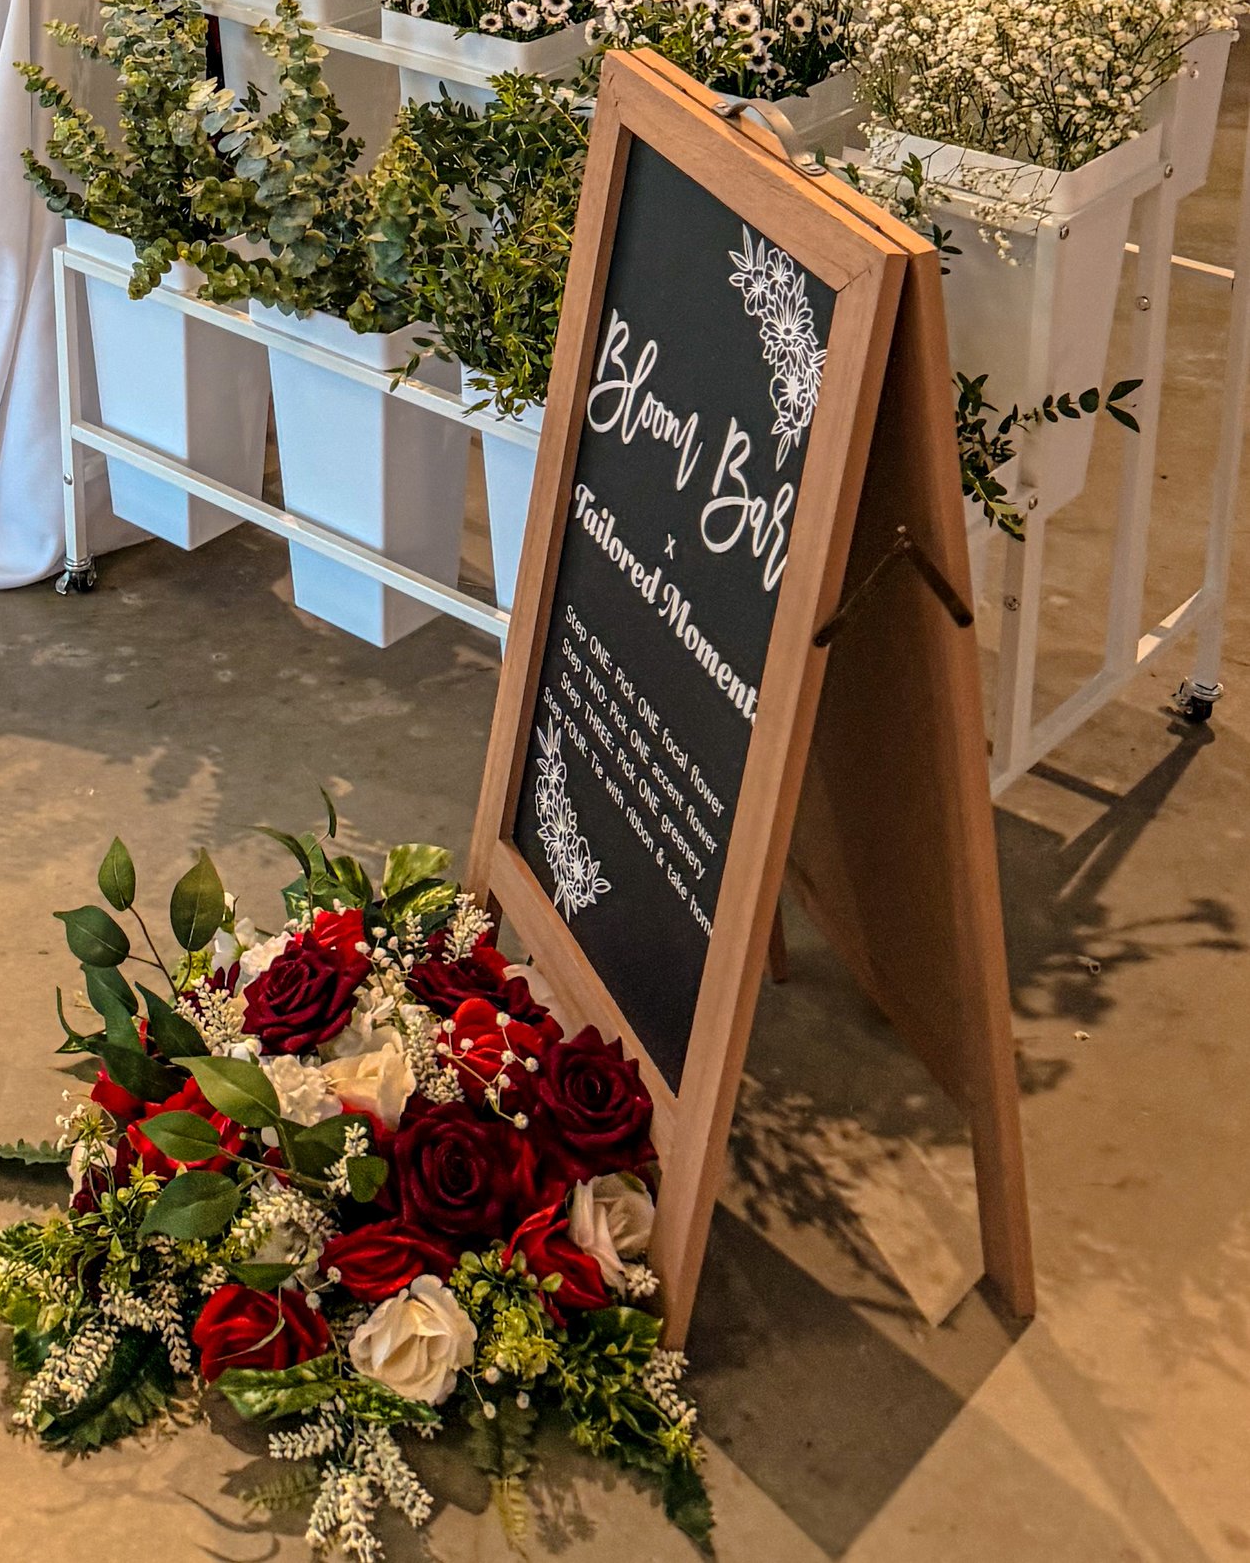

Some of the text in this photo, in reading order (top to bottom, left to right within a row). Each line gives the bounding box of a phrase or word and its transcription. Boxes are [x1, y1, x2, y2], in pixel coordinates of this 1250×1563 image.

[587, 308, 794, 592] Bloom Bar
[565, 604, 725, 819] Step ONE: Pick ONE focal flower
[574, 483, 758, 726] Tailored Moment
[543, 686, 562, 723] Step
[563, 714, 590, 759] FOUR:
[590, 749, 605, 781] Tie
[605, 775, 625, 811] with
[626, 806, 654, 855] ribbon
[655, 846, 666, 869] &
[667, 862, 688, 901] take
[560, 671, 707, 881] Step THREE: Pick ONE greenery
[561, 637, 718, 856] Step TWO: Pick ONE accent flower
